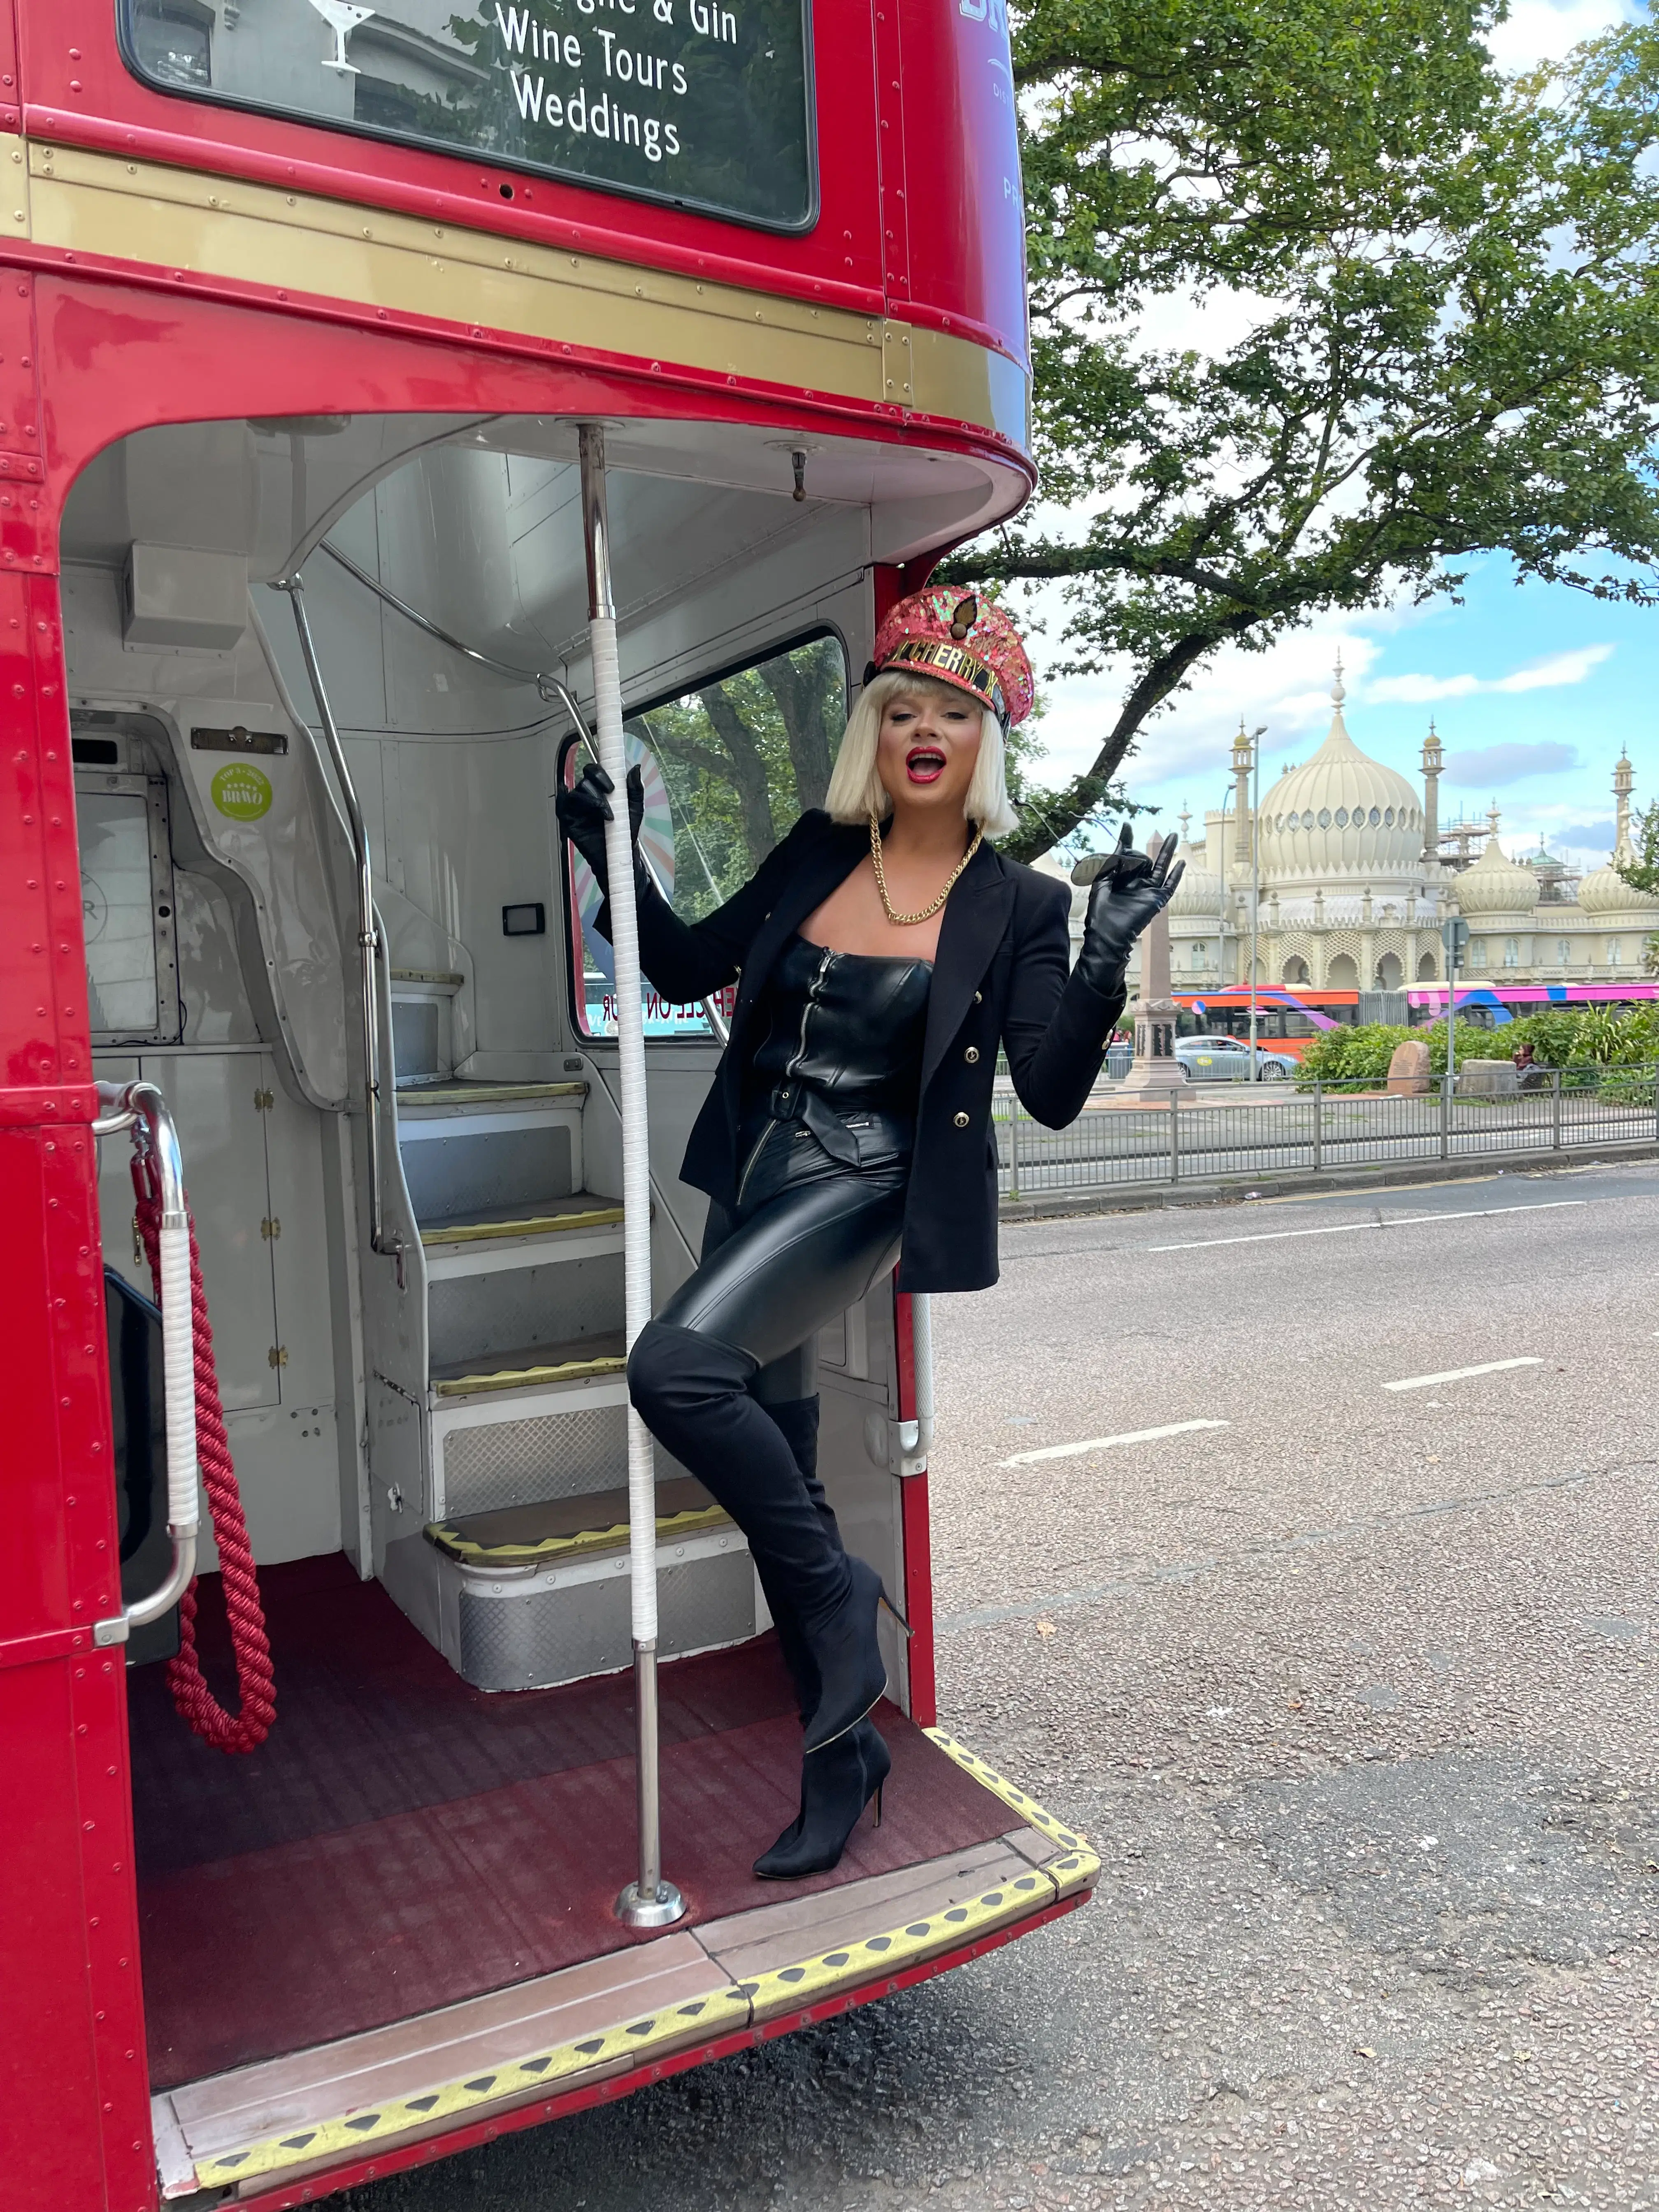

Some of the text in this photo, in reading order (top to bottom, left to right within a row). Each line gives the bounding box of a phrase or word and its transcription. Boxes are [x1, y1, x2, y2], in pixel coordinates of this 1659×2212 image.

[495, 2, 688, 95] Wine Tours
[653, 0, 674, 25] &
[690, 0, 737, 44] Gin
[510, 70, 680, 162] Weddings
[908, 641, 984, 683] CHERRY
[984, 670, 999, 699] X
[222, 790, 263, 804] BRAVO
